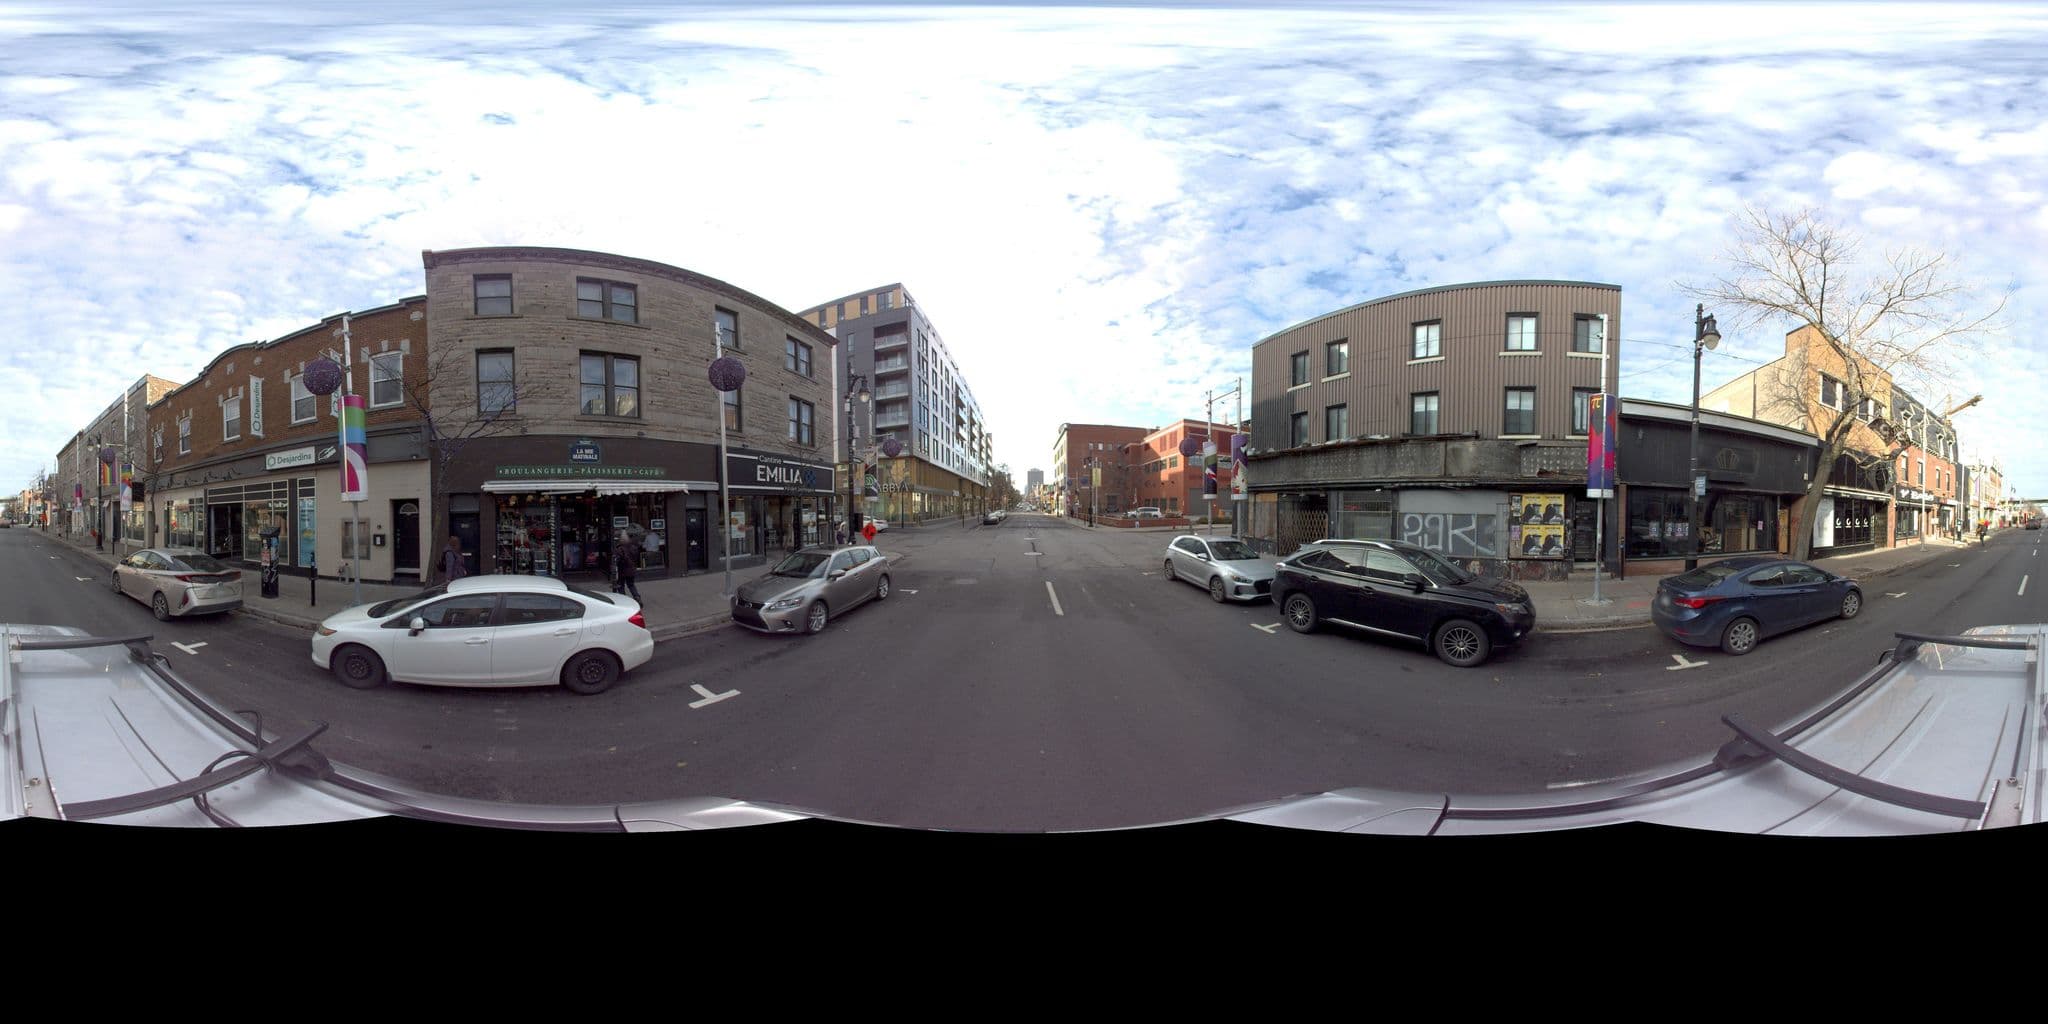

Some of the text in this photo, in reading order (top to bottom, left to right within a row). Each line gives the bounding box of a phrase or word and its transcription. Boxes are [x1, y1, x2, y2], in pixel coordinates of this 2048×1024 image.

[253, 381, 261, 419] Desjardins
[276, 453, 312, 465] Desjardins
[757, 454, 783, 464] Cantine
[504, 467, 574, 476] BOULANGERIE
[581, 466, 633, 476] PÂTISSERIE
[756, 465, 803, 485] EMILIA
